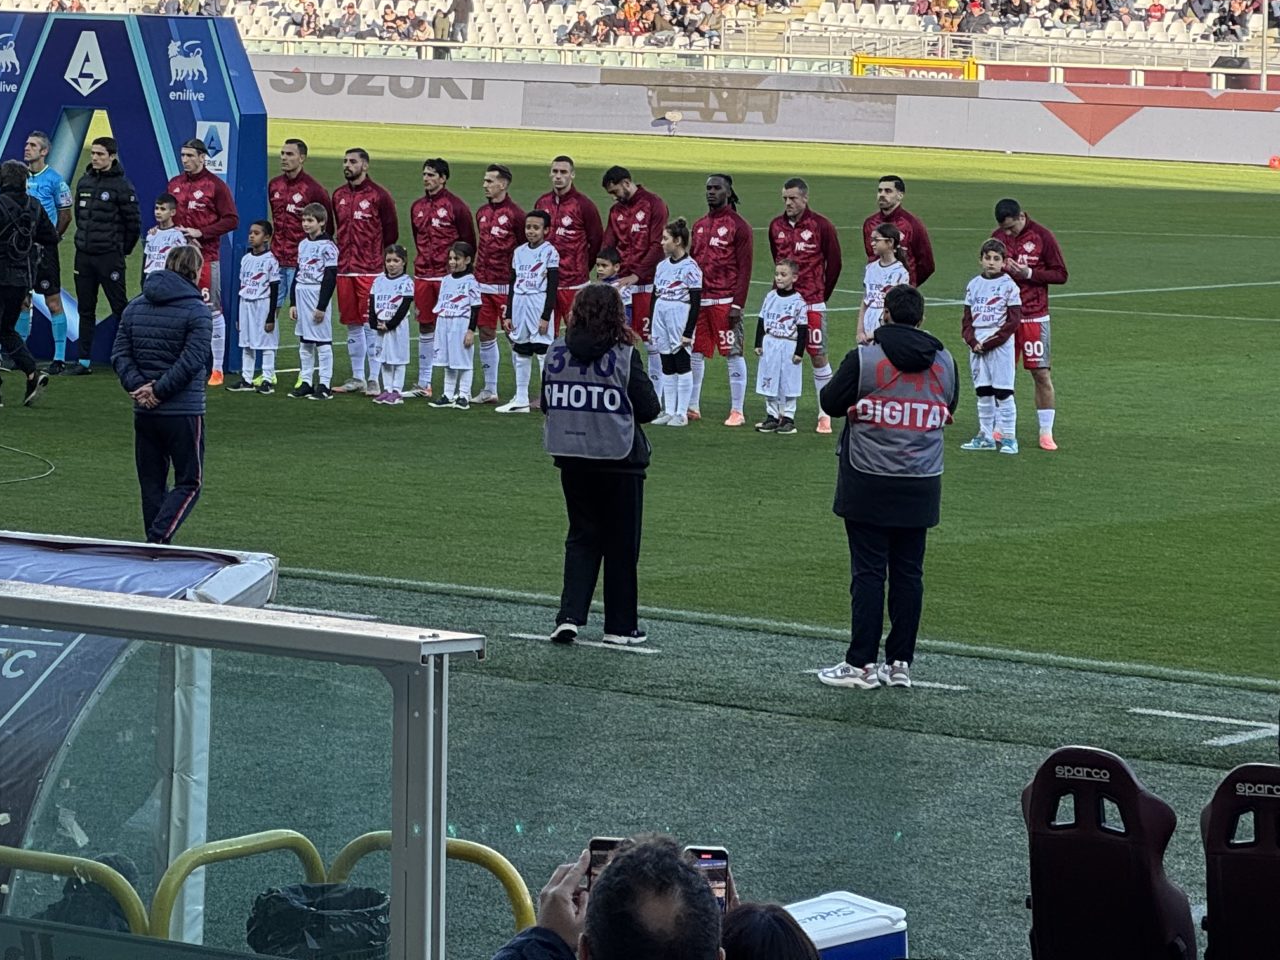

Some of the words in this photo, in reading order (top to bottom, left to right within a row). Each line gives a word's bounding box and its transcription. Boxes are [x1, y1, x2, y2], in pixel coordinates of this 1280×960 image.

[169, 90, 205, 102] enilive
[1024, 341, 1044, 357] 90
[545, 383, 621, 411] PHOTO
[1055, 765, 1110, 780] sparco
